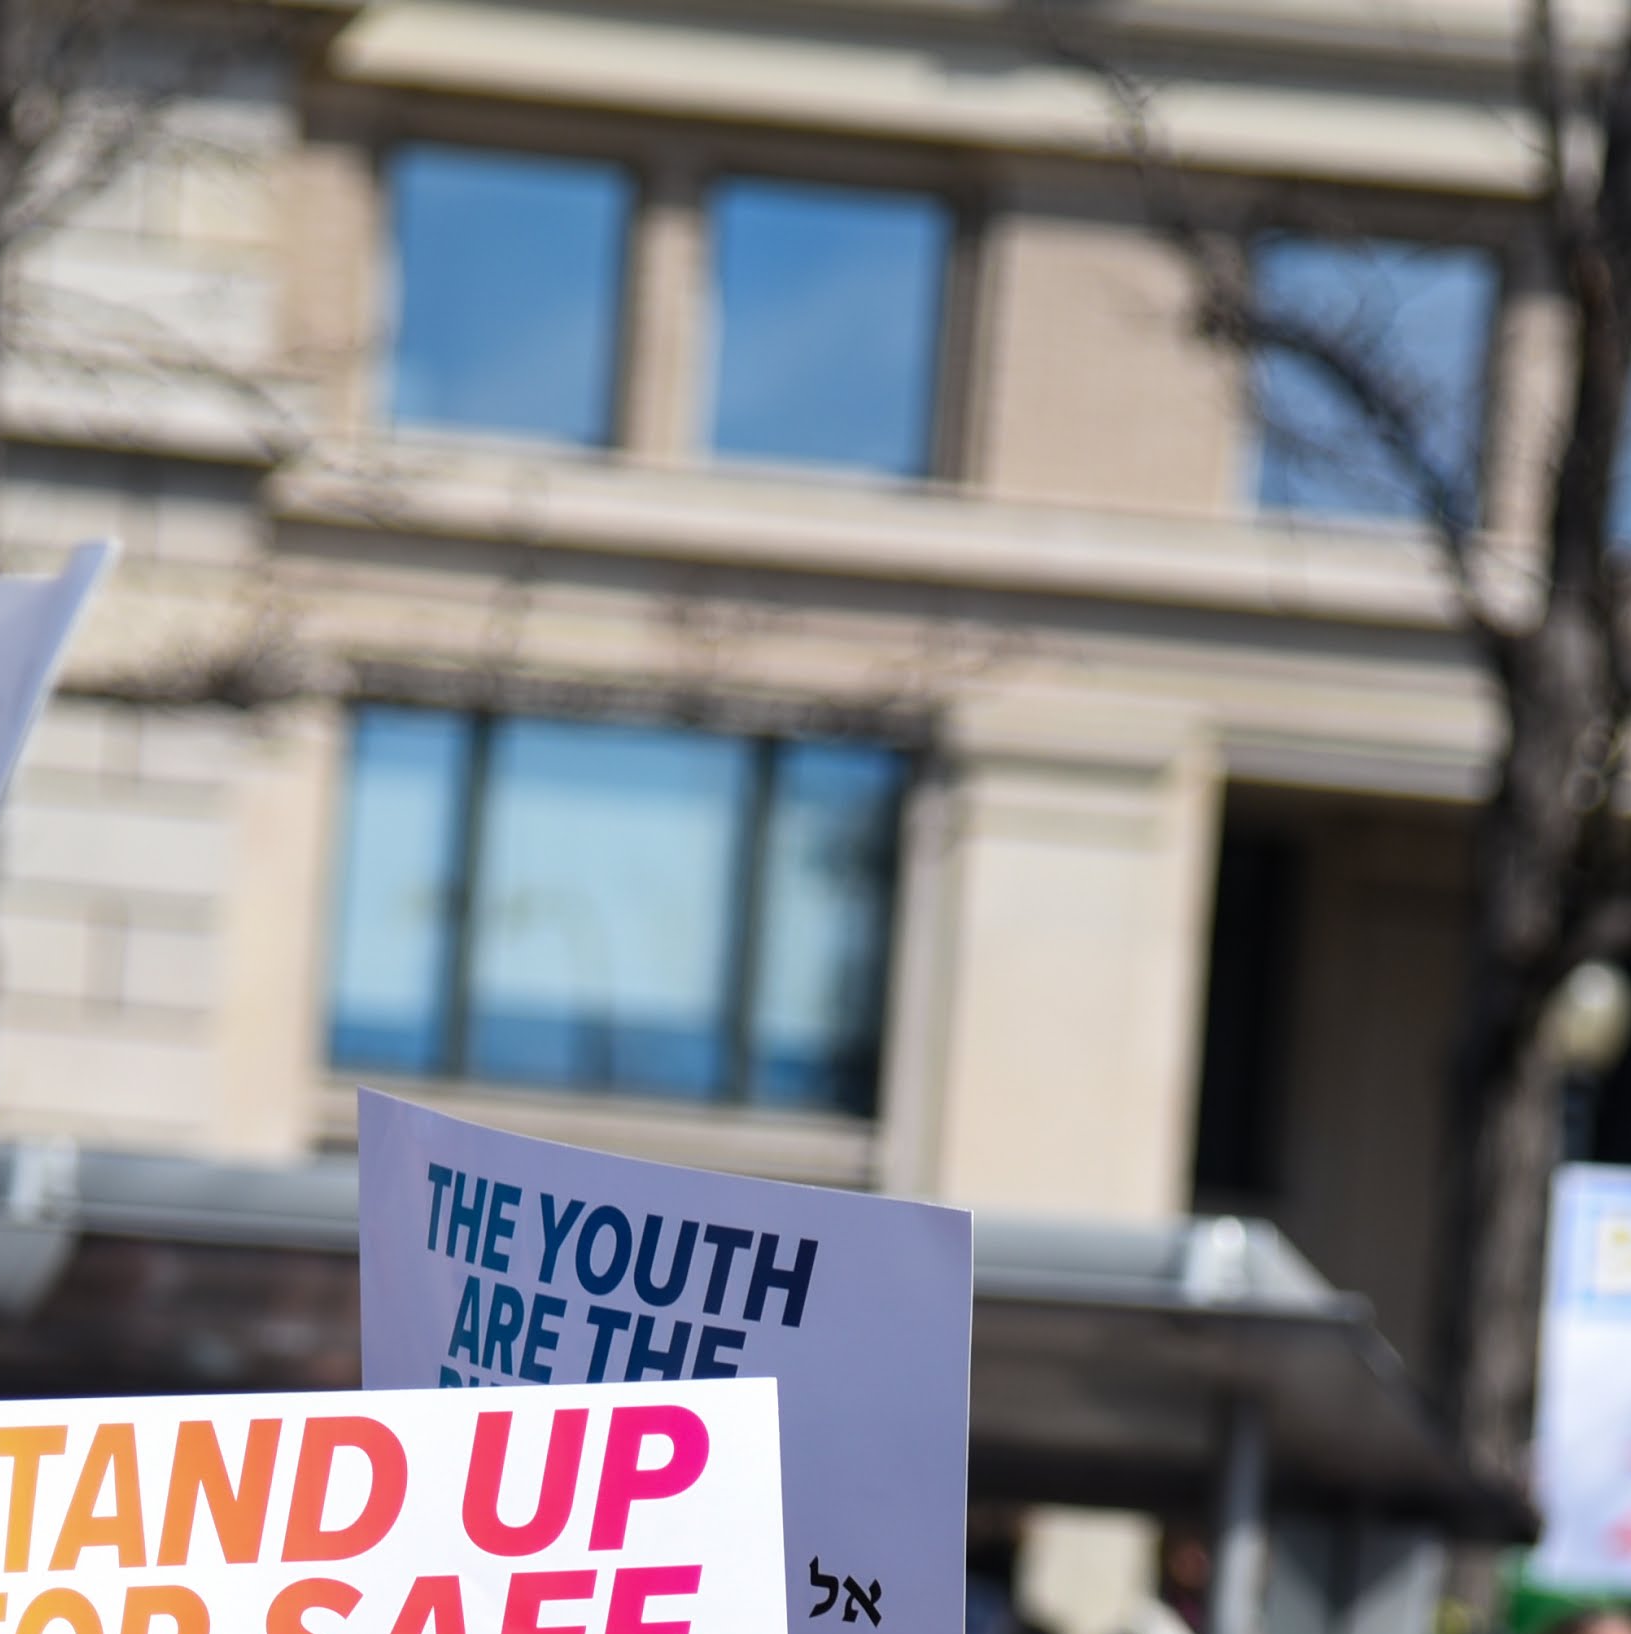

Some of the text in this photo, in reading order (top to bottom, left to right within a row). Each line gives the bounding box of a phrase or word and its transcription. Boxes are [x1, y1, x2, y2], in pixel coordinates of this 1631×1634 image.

[427, 1162, 819, 1329] THE YOUTH
[448, 1275, 747, 1386] ARE THE
[462, 1405, 709, 1557] UP
